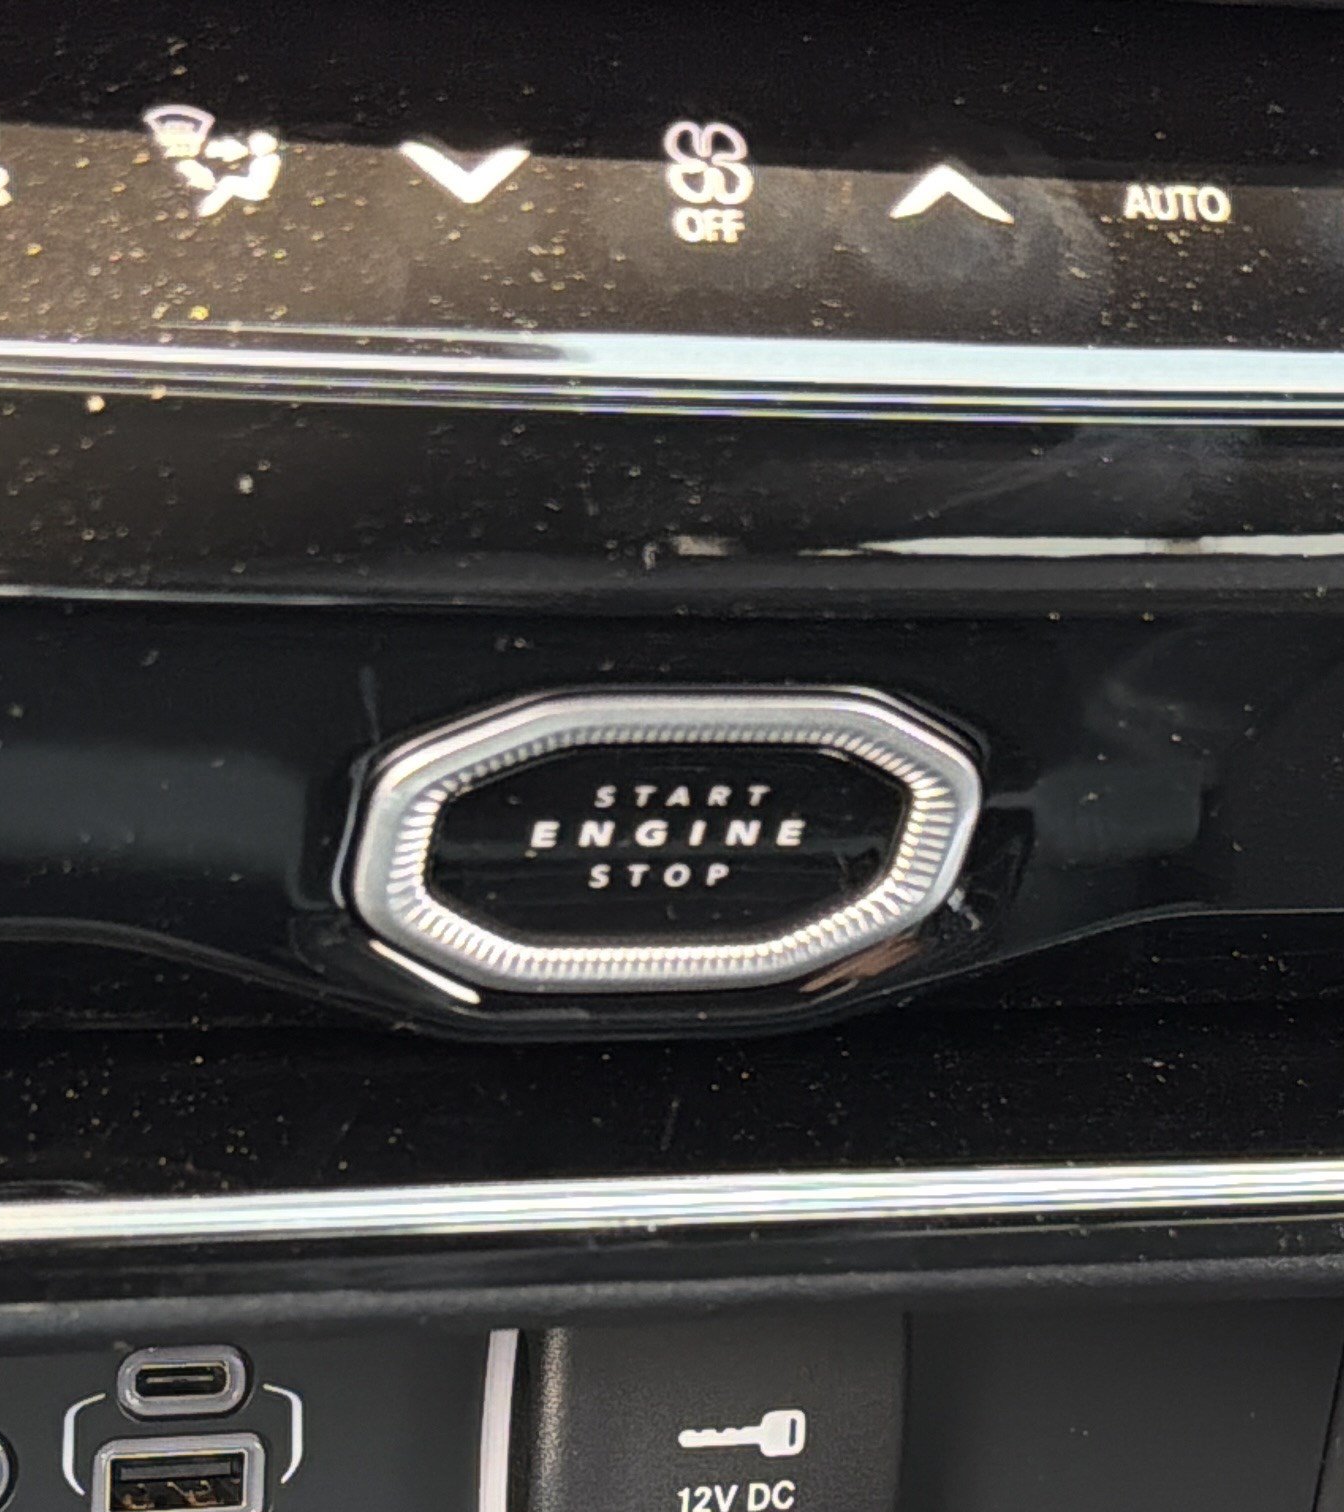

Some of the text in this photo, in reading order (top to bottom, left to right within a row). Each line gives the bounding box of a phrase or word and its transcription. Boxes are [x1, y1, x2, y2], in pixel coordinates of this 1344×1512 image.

[1123, 183, 1232, 223] AUTO
[671, 205, 746, 244] OFF
[594, 784, 770, 808] START
[530, 819, 806, 848] ENGINE
[588, 862, 730, 889] STOP
[747, 1479, 796, 1512] DC
